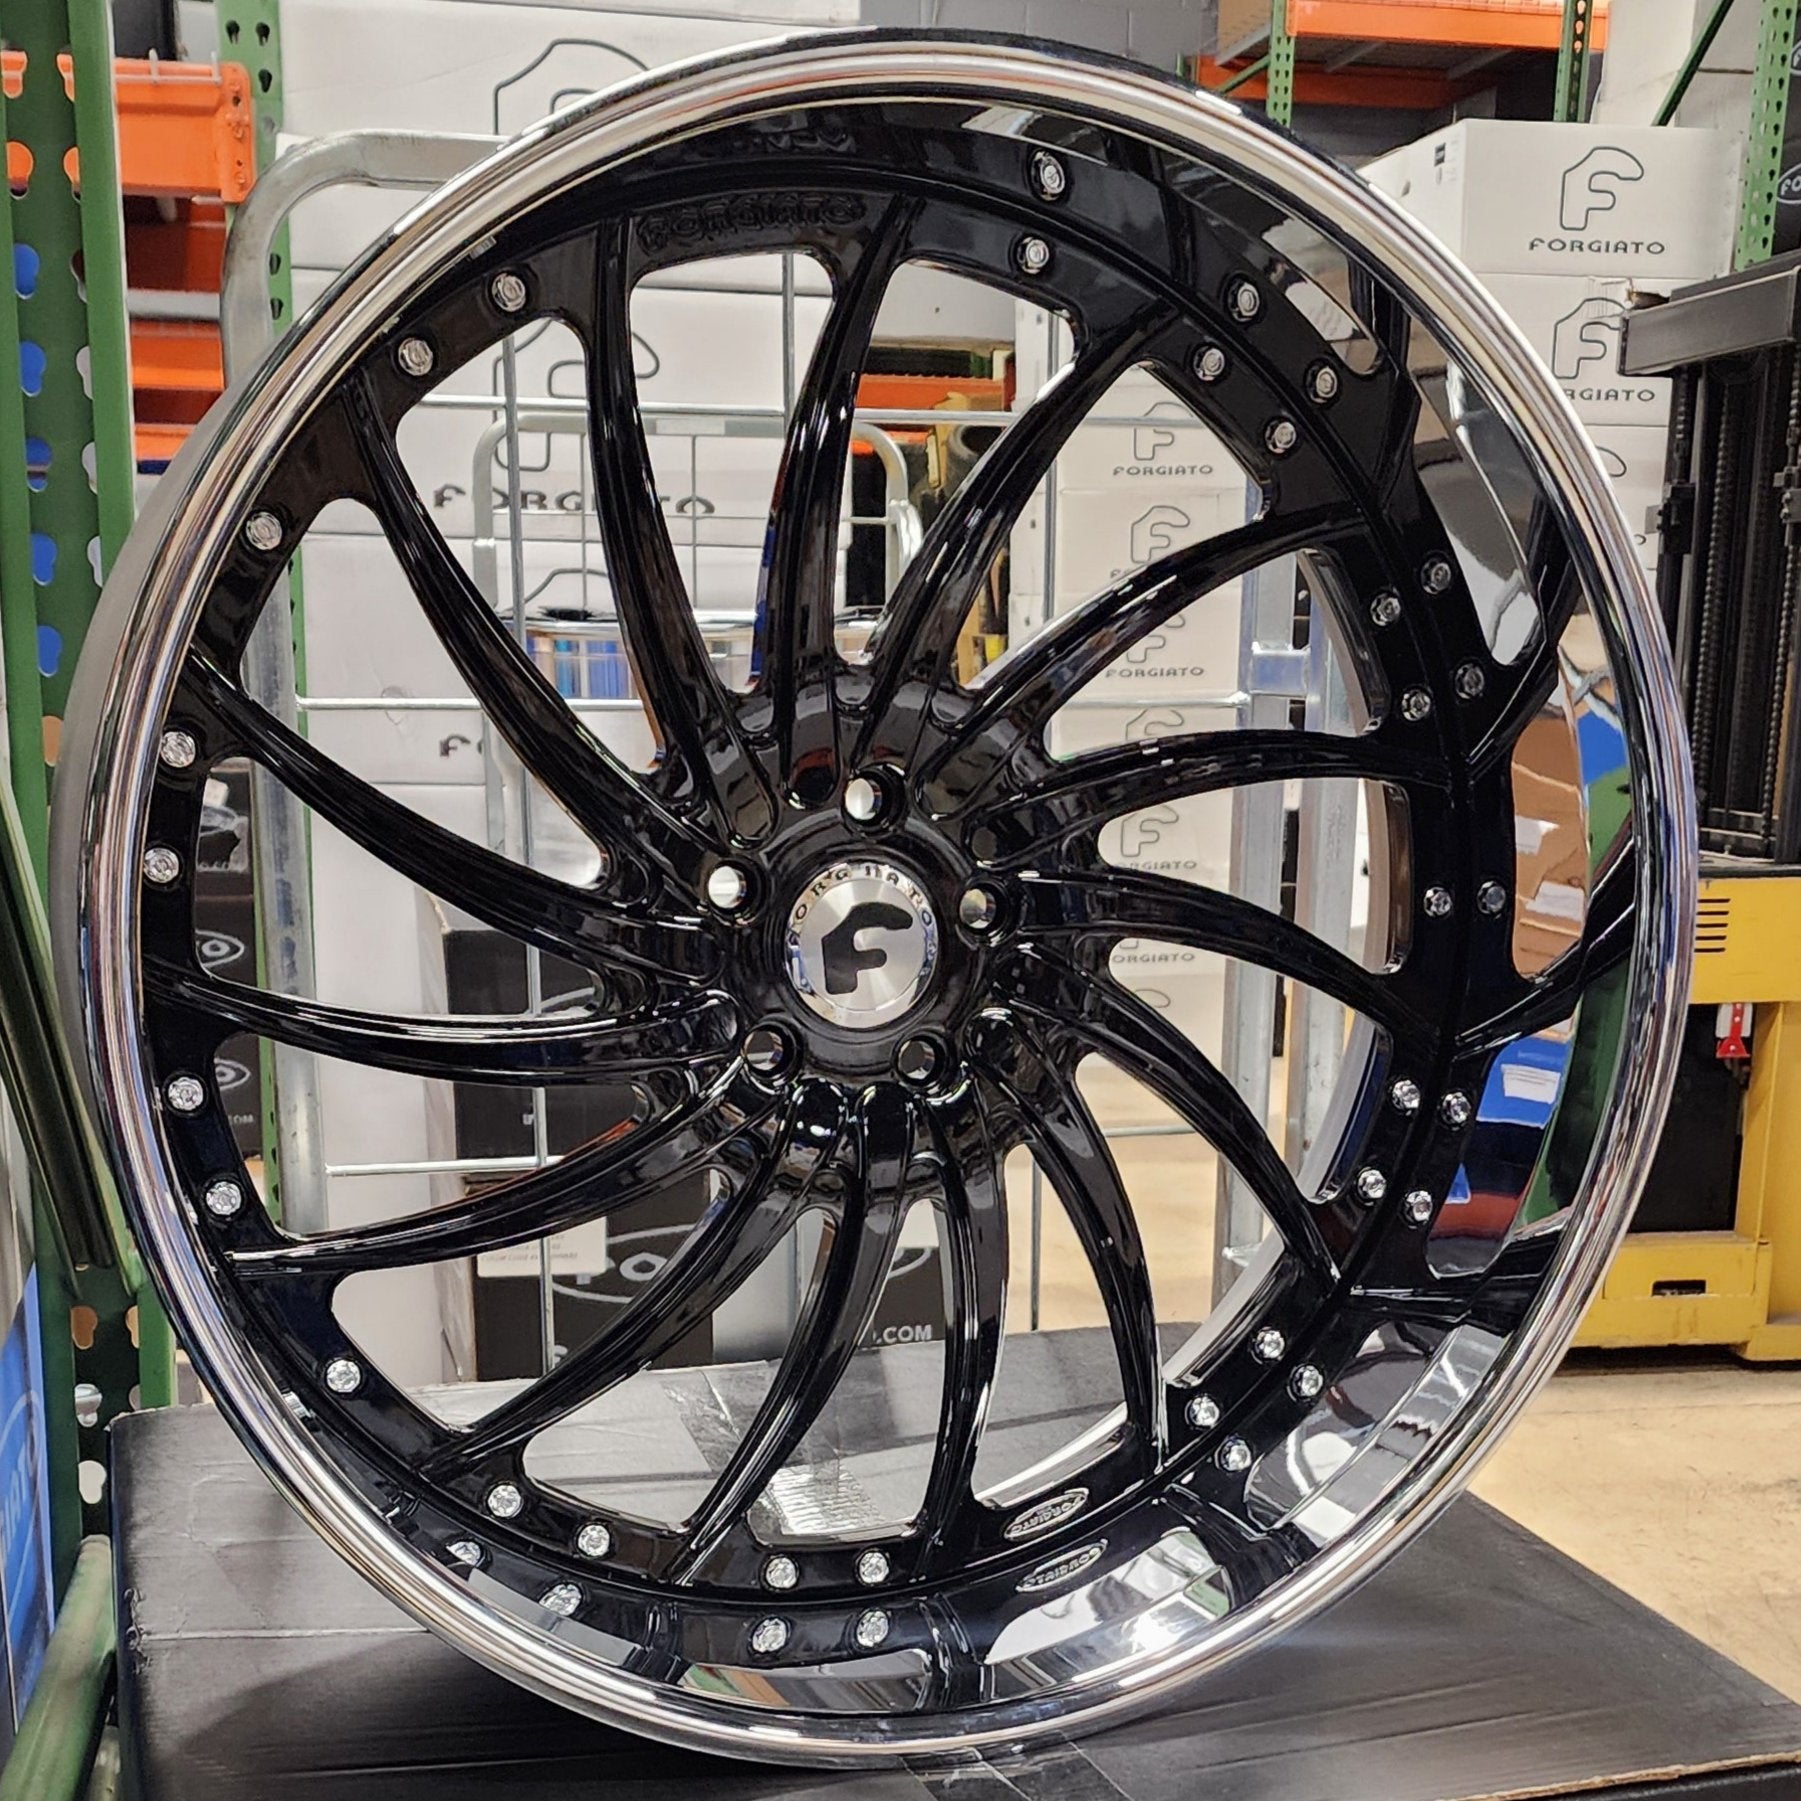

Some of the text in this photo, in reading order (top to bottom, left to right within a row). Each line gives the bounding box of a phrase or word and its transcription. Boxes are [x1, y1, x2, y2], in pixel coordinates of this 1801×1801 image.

[1529, 238, 1665, 255] FORGIATO
[1563, 387, 1656, 402] RGIATO
[1112, 464, 1213, 476] FORGIATO
[1105, 666, 1204, 678] FORGIATO
[1129, 860, 1198, 870] RGIATO
[1112, 952, 1196, 963] ORGIATO
[873, 1324, 932, 1343] .COM
